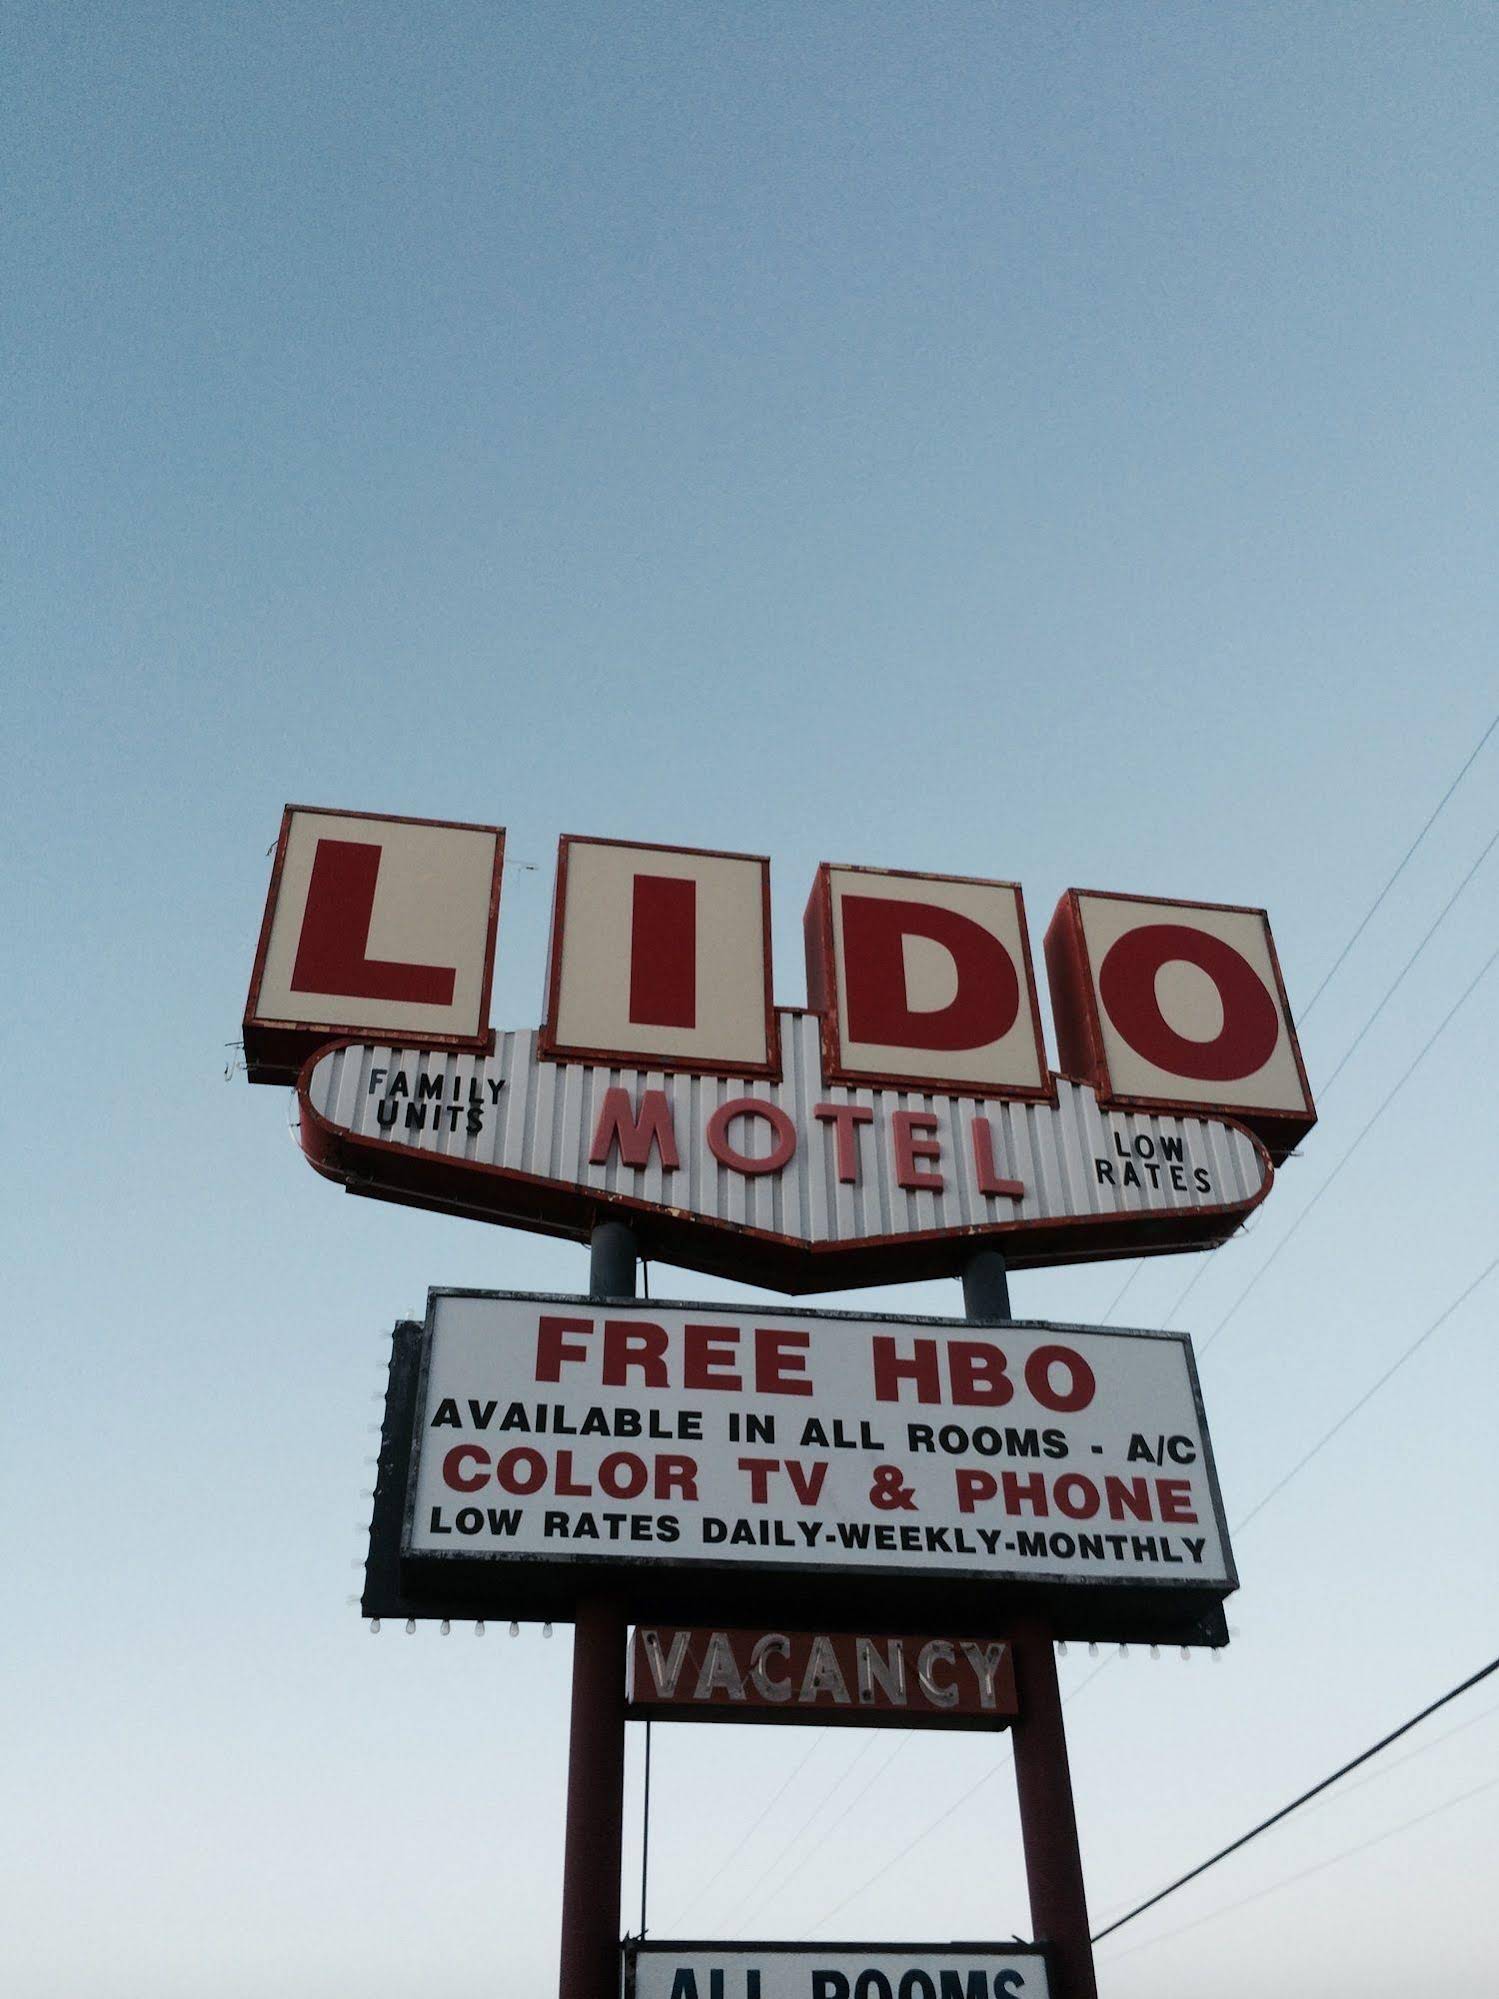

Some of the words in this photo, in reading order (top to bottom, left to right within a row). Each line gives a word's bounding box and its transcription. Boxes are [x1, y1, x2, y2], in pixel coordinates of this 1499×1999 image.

[290, 838, 1279, 1082] LIDO
[368, 1068, 506, 1106] FAMILY
[376, 1099, 486, 1136] UNITS
[589, 1086, 1025, 1202] MOTEL
[1095, 1158, 1212, 1194] RATES
[1114, 1131, 1184, 1161] LOW
[535, 1315, 814, 1397] FREE
[872, 1335, 1096, 1413] HBO
[431, 1398, 703, 1441] AVAILABLE
[729, 1413, 775, 1444] IN
[800, 1417, 885, 1451] ALL
[907, 1423, 1069, 1459] ROOMS
[1126, 1433, 1197, 1466] A/C
[442, 1444, 699, 1501] COLOR
[738, 1457, 829, 1507] TV
[869, 1464, 919, 1511] &
[955, 1468, 1199, 1524] PHONE
[430, 1506, 523, 1536] LOW
[544, 1511, 680, 1542] RATES
[641, 1630, 1007, 1710] VACANCY
